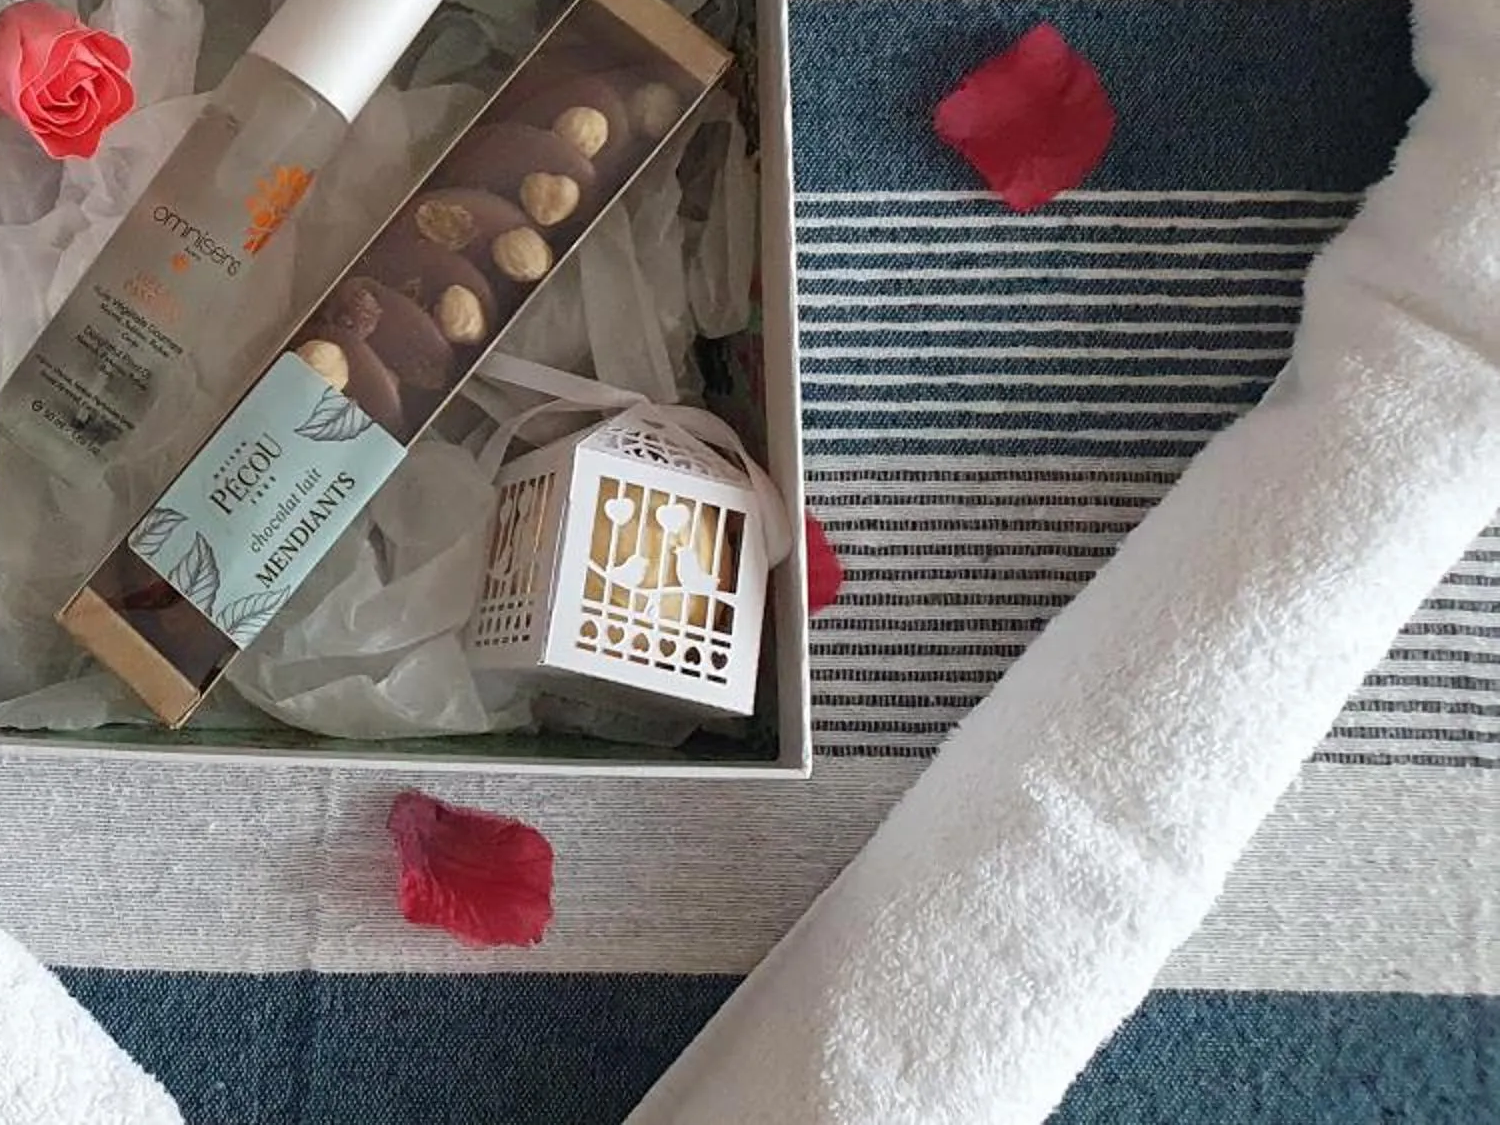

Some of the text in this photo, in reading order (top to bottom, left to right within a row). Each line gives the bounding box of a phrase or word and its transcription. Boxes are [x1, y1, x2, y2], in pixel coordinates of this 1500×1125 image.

[153, 206, 241, 276] omnisens
[209, 432, 283, 515] PÉCOU
[251, 493, 301, 554] chocolat
[295, 467, 322, 496] lait
[255, 472, 355, 589] MENDIANTS
